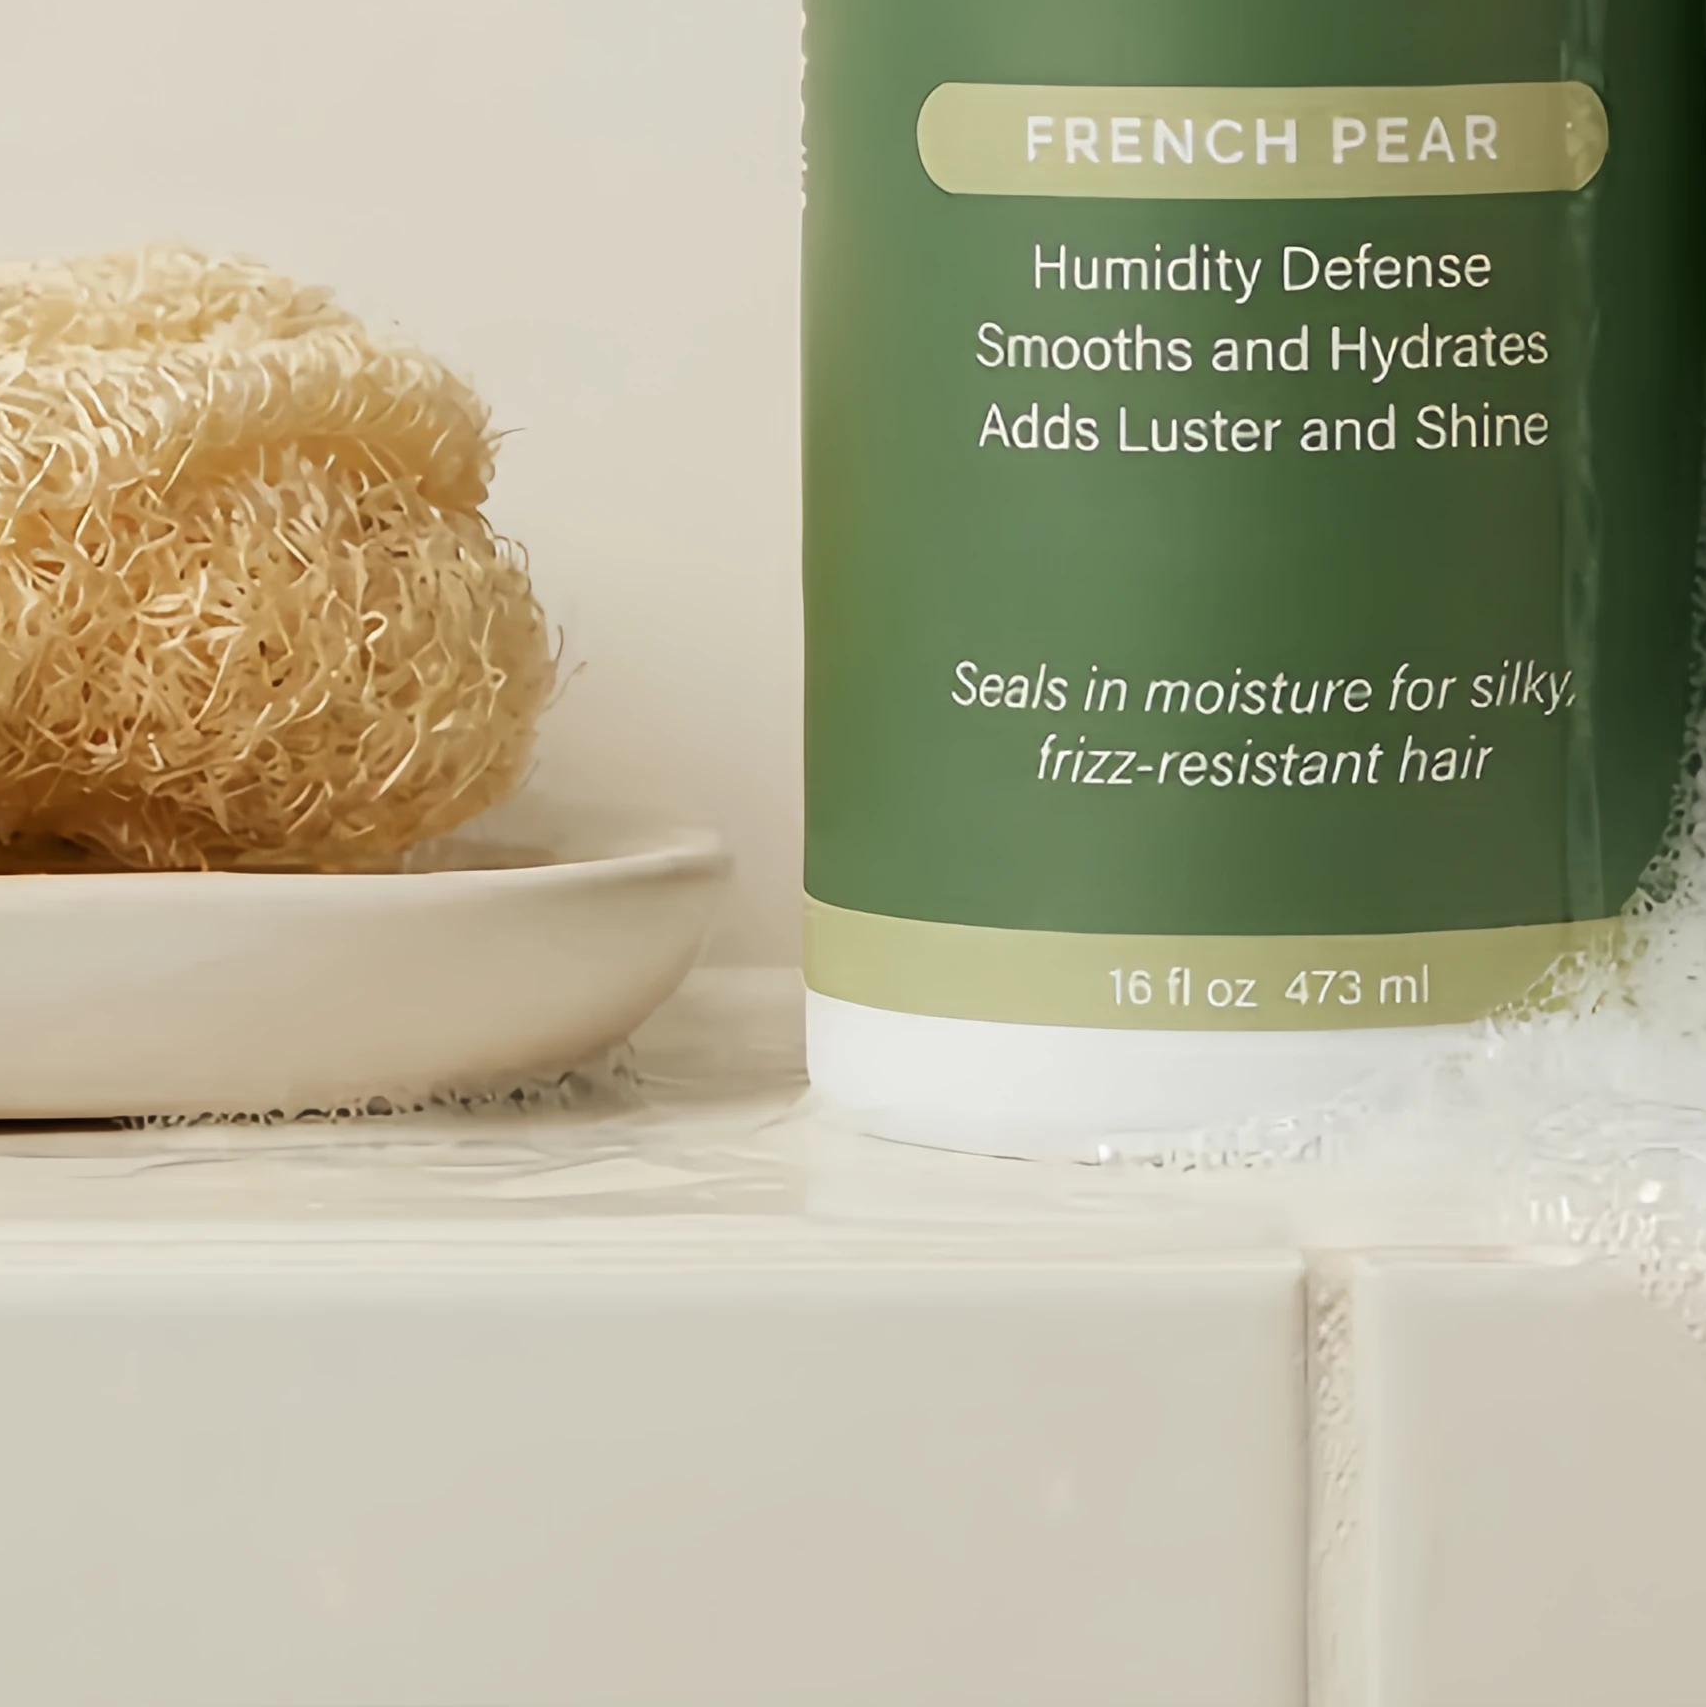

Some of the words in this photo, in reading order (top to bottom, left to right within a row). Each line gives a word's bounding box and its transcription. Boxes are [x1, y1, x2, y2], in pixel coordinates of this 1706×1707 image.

[1027, 116, 1296, 165] FRENCH
[1333, 115, 1497, 164] PEAR
[1035, 244, 1261, 304] Humidity
[1284, 243, 1491, 291] Defense
[977, 322, 1192, 371] Smooths
[1212, 325, 1308, 371] and
[1332, 323, 1548, 383] Hydrates
[979, 403, 1099, 451] Adds
[1120, 407, 1282, 452] Luster
[1300, 404, 1395, 451] and
[1416, 403, 1548, 449] Shine
[952, 661, 1068, 711] Seals
[1084, 664, 1127, 711] in
[1145, 666, 1372, 715] moisture
[1389, 663, 1457, 711] for
[1471, 660, 1575, 715] silky,
[1038, 734, 1384, 786] frizz-resistant
[1399, 735, 1493, 783] hair
[1110, 968, 1152, 1005] 16
[1167, 967, 1190, 1006] fl
[1207, 979, 1257, 1007] oz
[1285, 970, 1361, 1005] 473
[1380, 964, 1428, 1004] ml
